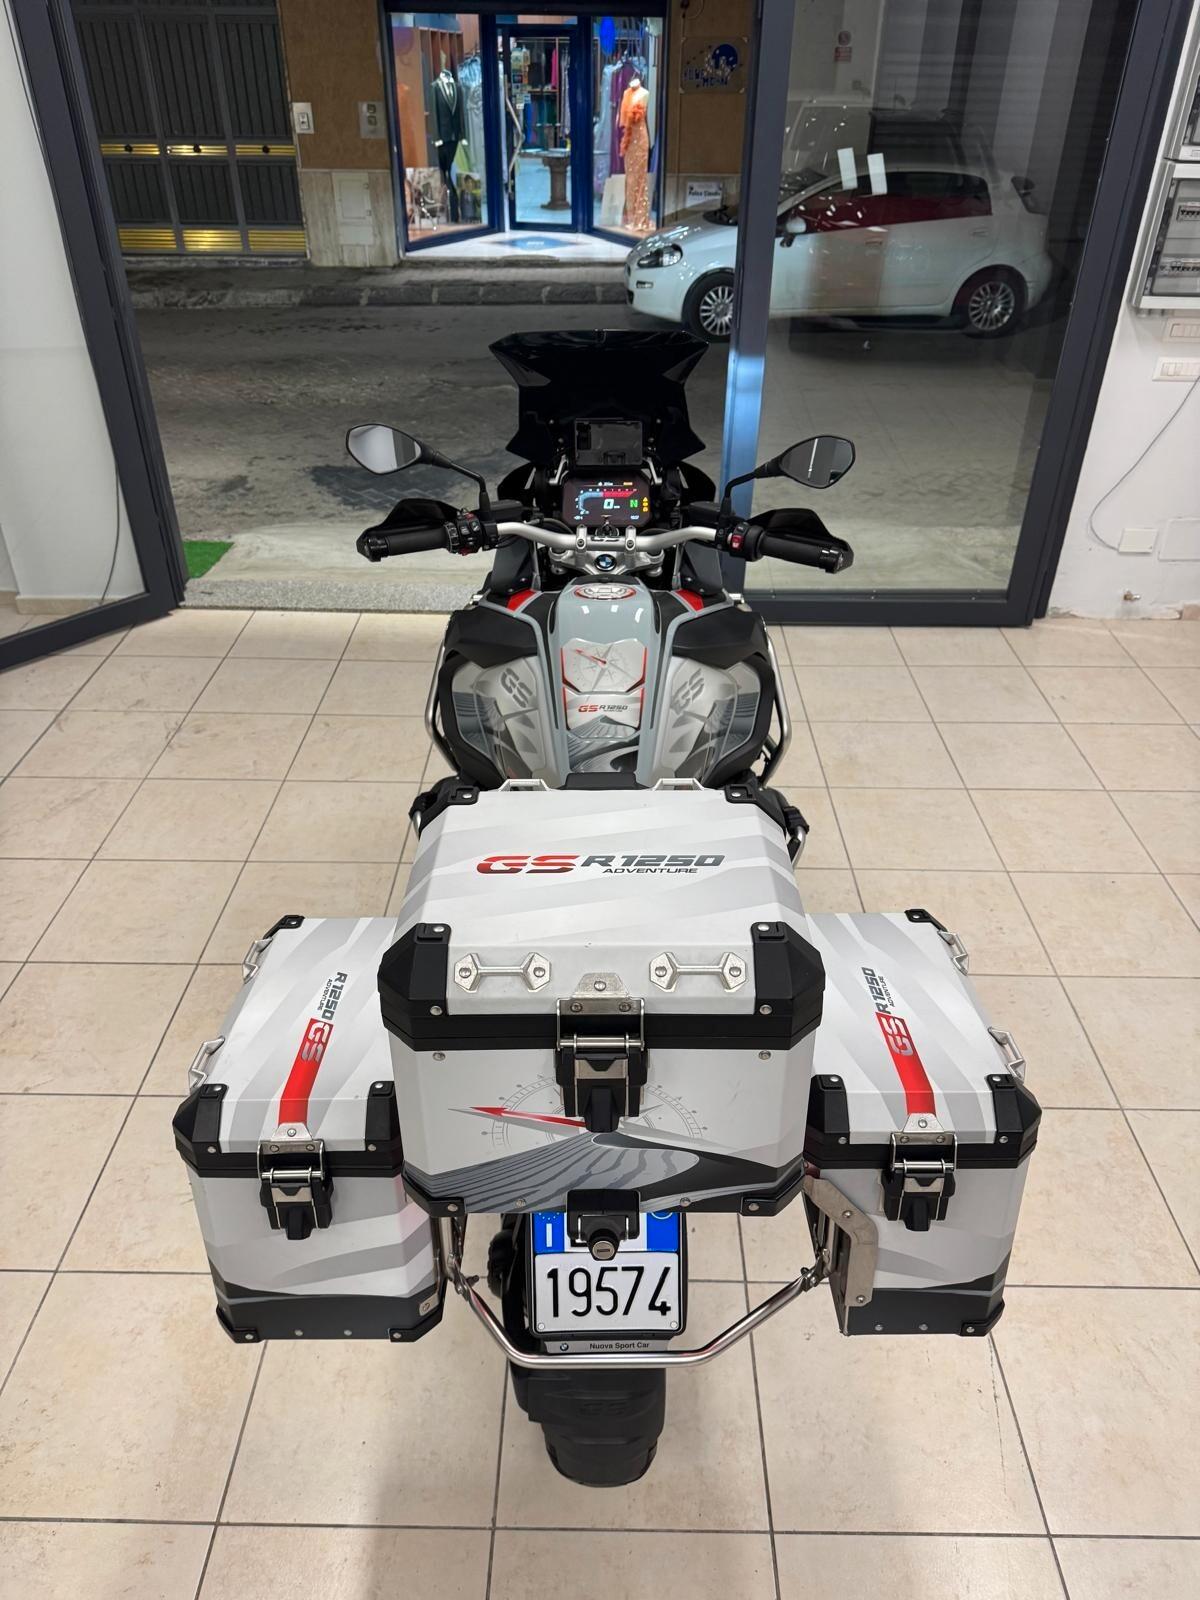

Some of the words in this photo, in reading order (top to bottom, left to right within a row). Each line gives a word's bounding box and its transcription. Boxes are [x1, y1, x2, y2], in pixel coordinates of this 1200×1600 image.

[630, 499, 639, 508] N
[501, 668, 533, 708] GS
[578, 704, 599, 713] GS
[477, 855, 580, 874] GS
[302, 1022, 330, 1062] GS
[880, 1017, 913, 1056] GS
[547, 1265, 672, 1318] 19574
[615, 1342, 635, 1350] Sport
